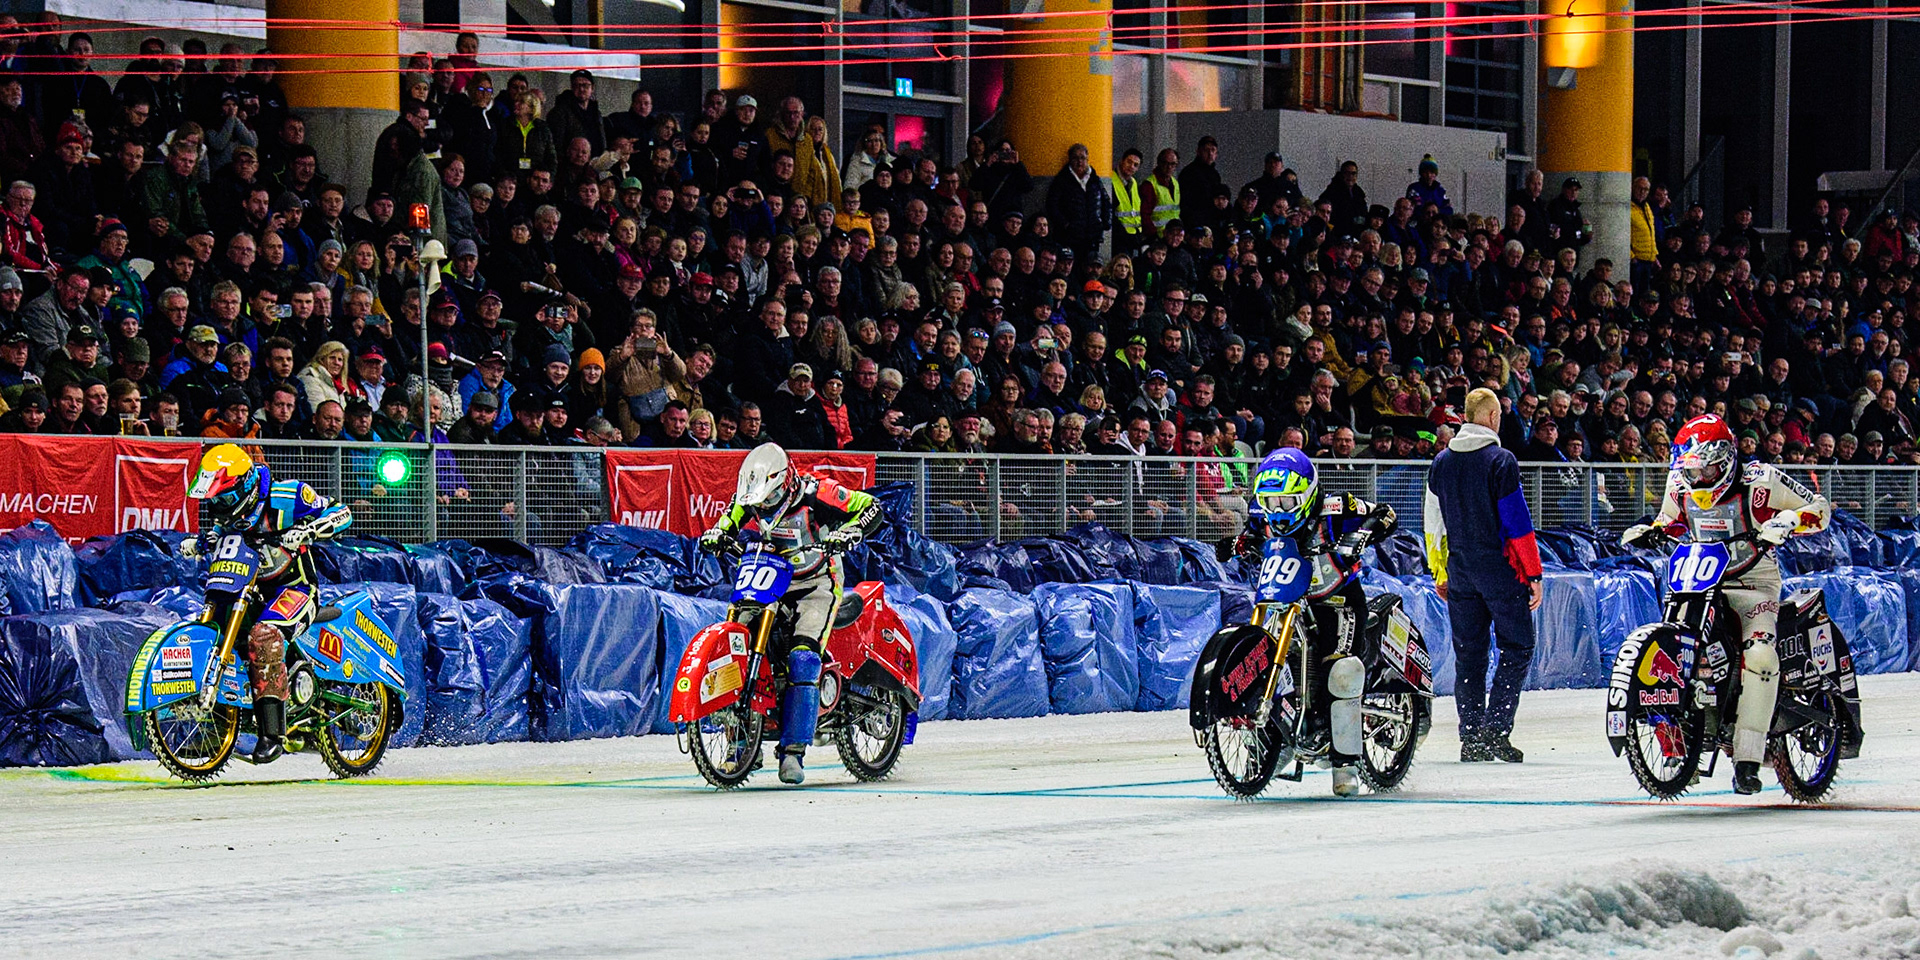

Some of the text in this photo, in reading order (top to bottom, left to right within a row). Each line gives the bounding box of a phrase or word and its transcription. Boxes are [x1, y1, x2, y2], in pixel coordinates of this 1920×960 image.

[1744, 469, 1766, 477] UCHS
[0, 492, 98, 515] MACHEN
[735, 565, 777, 590] 50
[1671, 556, 1720, 582] 100
[355, 608, 398, 660] THORWESTEN
[163, 648, 191, 660] HACHER
[1778, 634, 1804, 661] 100
[1812, 641, 1833, 658] FUCHS
[128, 630, 168, 706] THORWESTEN
[151, 680, 197, 696] THORWESTEN
[1640, 688, 1679, 705] Red Bull
